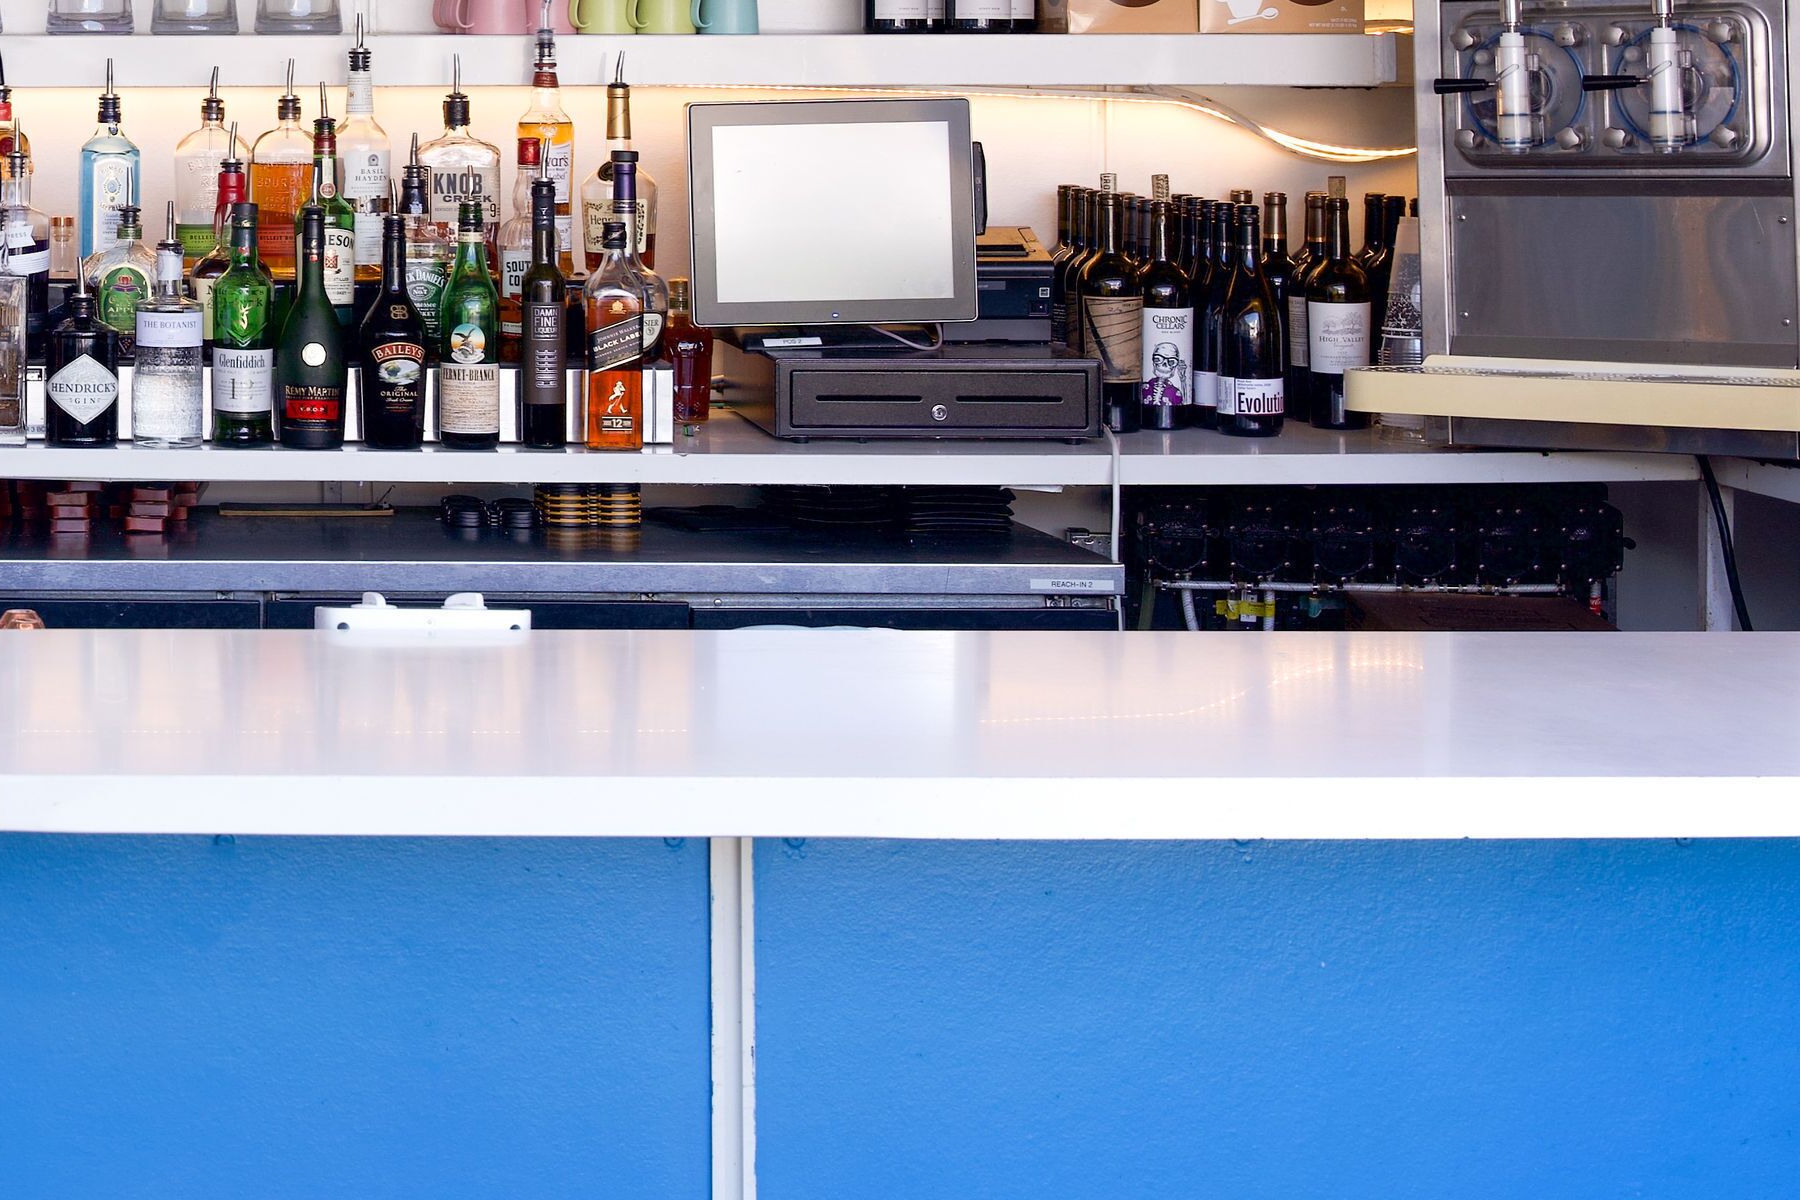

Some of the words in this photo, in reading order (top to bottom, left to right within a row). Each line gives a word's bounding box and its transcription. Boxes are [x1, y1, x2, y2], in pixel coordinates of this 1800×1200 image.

[434, 174, 483, 194] KNOB
[143, 320, 158, 329] THE
[159, 319, 197, 330] BOTANIST
[534, 316, 557, 326] FINE
[1152, 313, 1188, 325] CHRONIC
[1155, 321, 1186, 331] CELLARS
[593, 339, 620, 352] BLACK
[375, 345, 423, 358] BAILEYS
[219, 352, 265, 370] Glenfiddich
[51, 380, 116, 393] HENDRICK'S
[308, 386, 340, 397] MARTIN
[74, 397, 97, 405] GIN
[612, 419, 623, 428] 12
